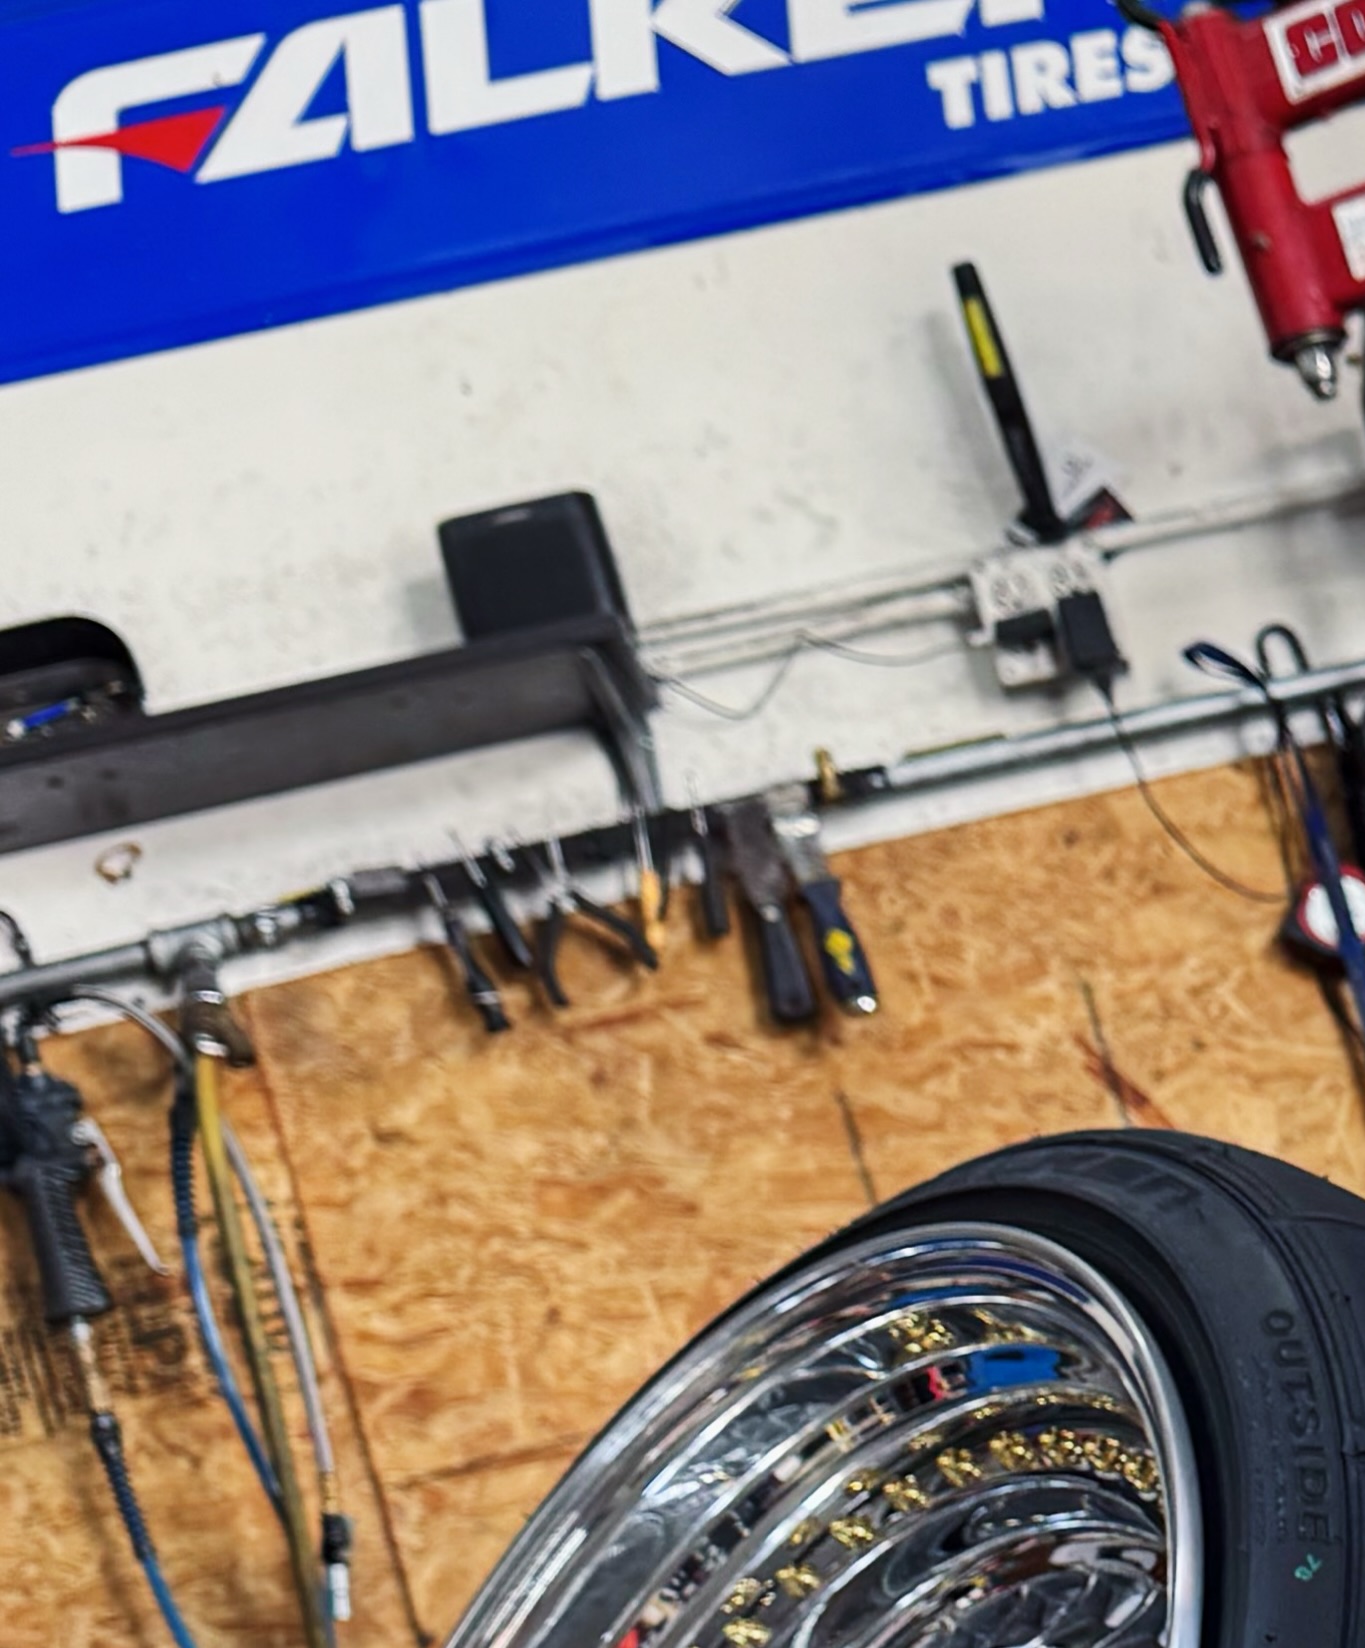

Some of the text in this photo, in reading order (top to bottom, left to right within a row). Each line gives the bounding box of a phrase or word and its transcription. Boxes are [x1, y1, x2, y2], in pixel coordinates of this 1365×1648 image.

[54, 0, 1043, 213] FALK
[926, 27, 1176, 130] TIRES
[1263, 1308, 1334, 1546] OUTSIDE
